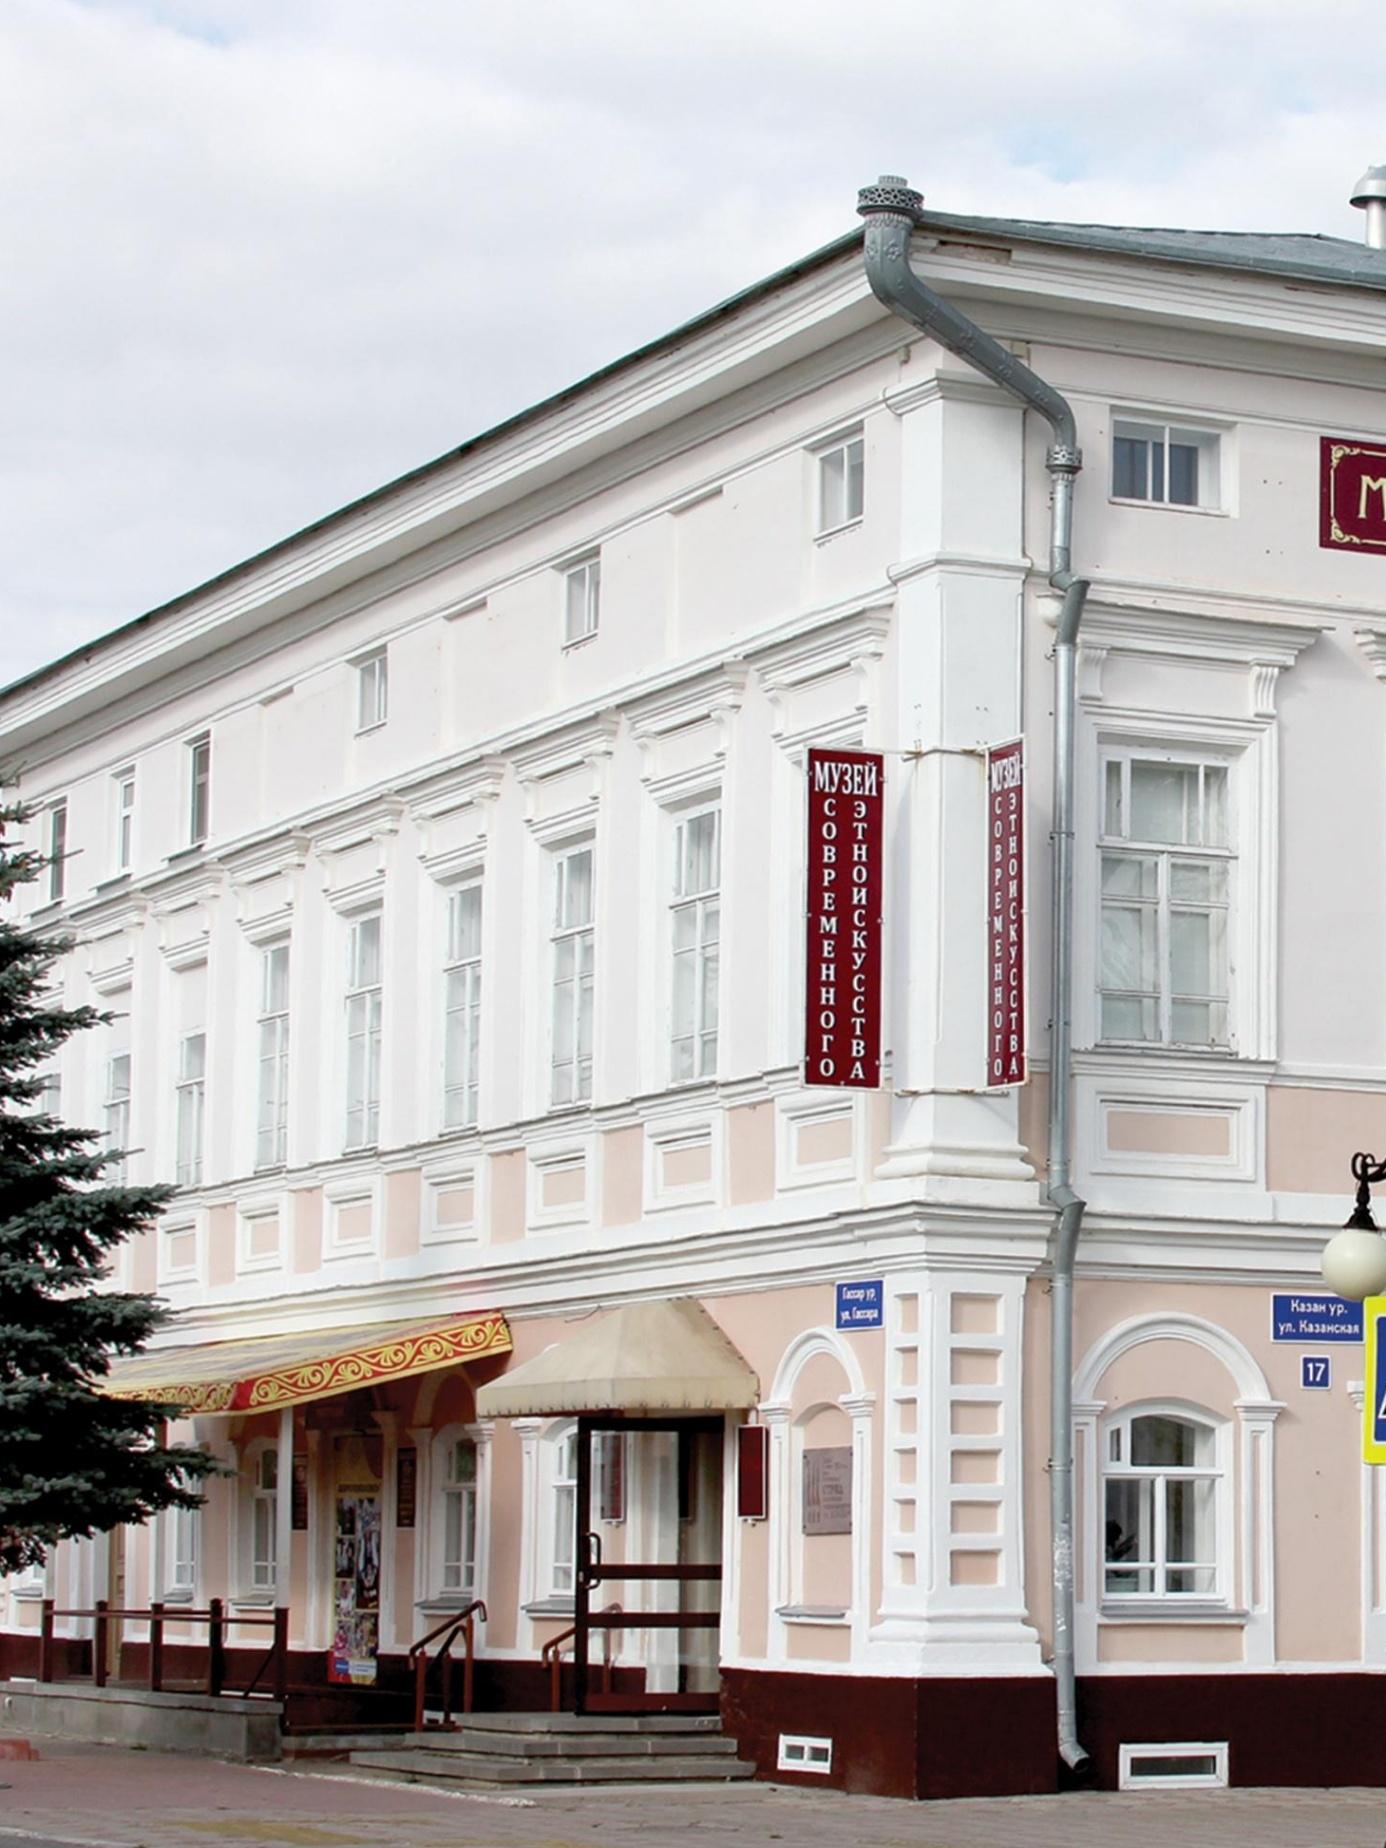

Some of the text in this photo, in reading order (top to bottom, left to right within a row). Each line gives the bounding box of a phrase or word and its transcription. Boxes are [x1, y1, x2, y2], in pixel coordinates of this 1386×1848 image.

[813, 761, 879, 797] МУЗЕЙ
[989, 751, 1021, 795] МУЗЕЙ
[818, 798, 838, 1078] СОВРЕМЕННОГО
[849, 801, 868, 1080] ЭТНОИСКУССТВА
[993, 796, 1003, 1077] СОВРЕМЕННОГО
[1008, 792, 1019, 1076] ЭТНОИСКУССТВА
[1278, 1320, 1360, 1335] ул. Казанская
[1290, 1299, 1348, 1316] Казан ур.
[1306, 1362, 1326, 1382] 17
